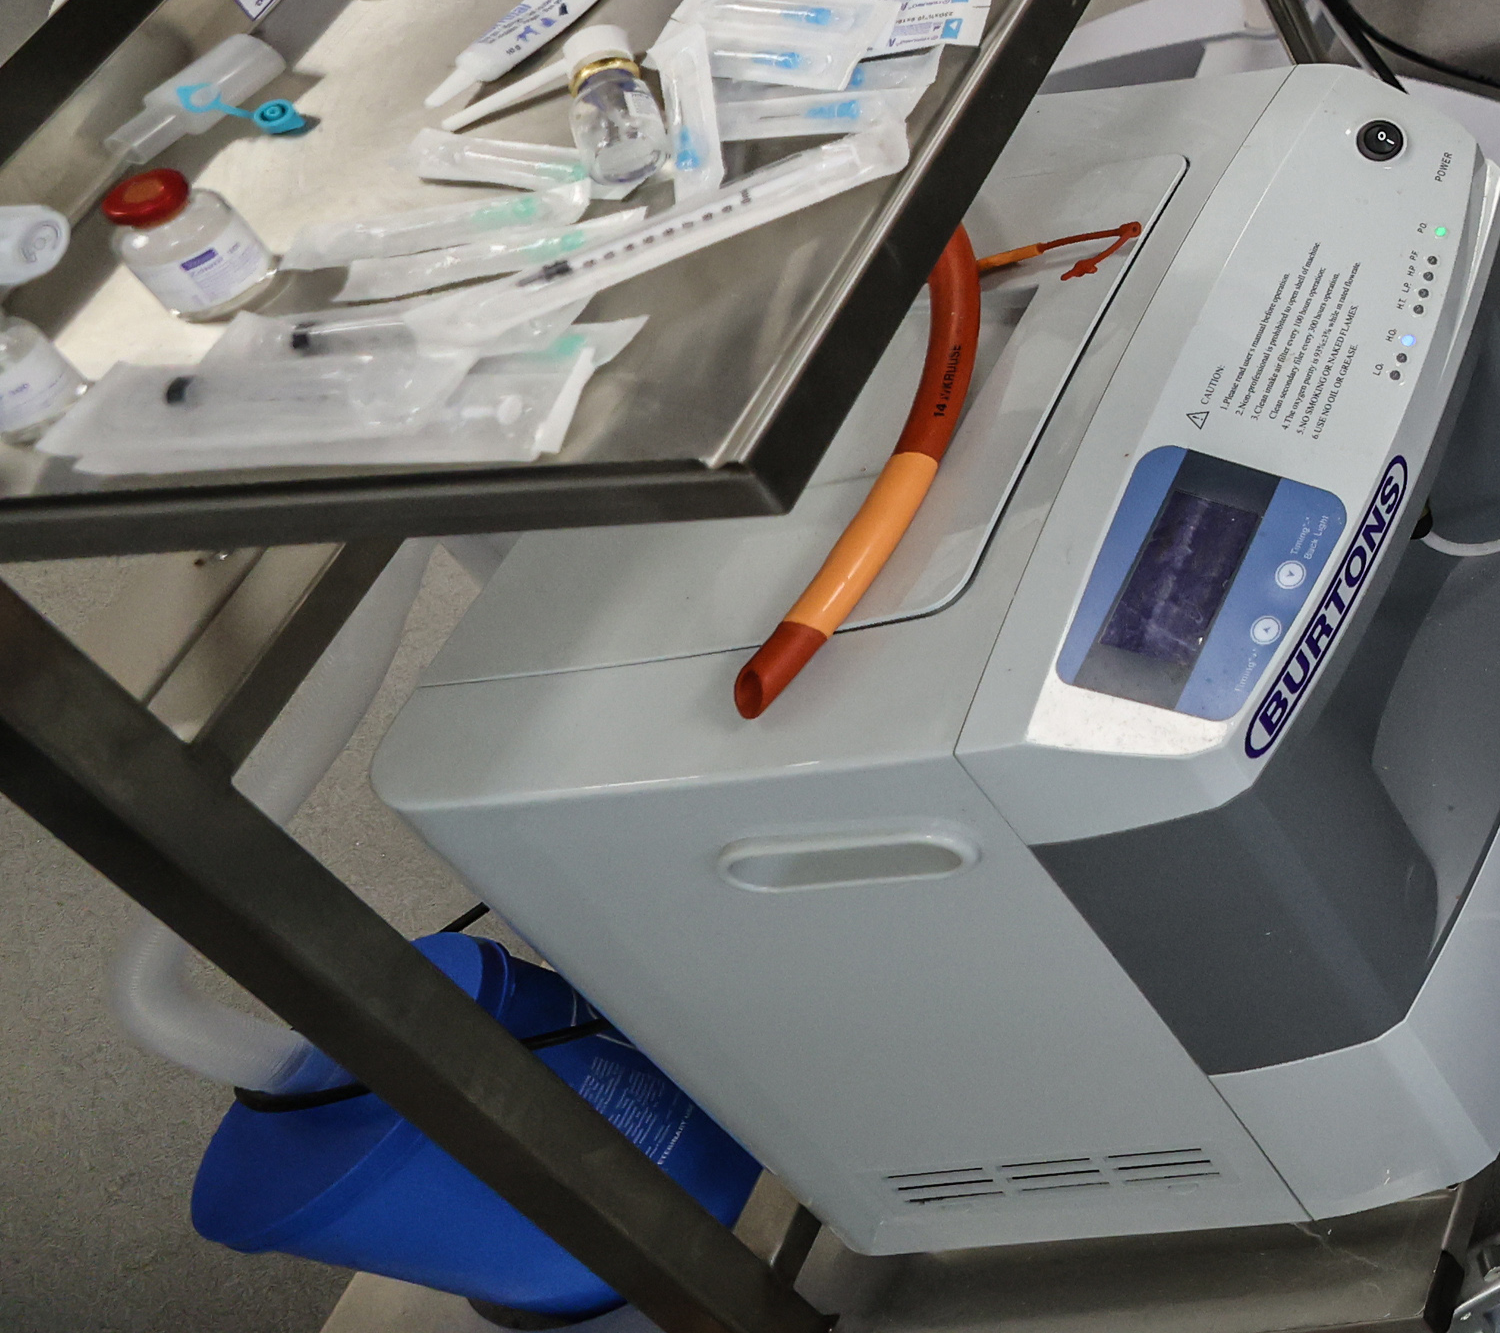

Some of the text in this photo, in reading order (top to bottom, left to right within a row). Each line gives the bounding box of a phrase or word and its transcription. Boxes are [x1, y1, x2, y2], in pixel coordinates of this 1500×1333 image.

[1435, 152, 1453, 183] POWER
[1299, 266, 1309, 275] of
[1293, 273, 1305, 290] shell
[1287, 289, 1300, 306] open
[1337, 286, 1350, 303] rated
[1283, 304, 1292, 313] to
[1298, 296, 1312, 316] hours
[1335, 302, 1343, 311] in
[1292, 313, 1304, 327] 100
[1325, 308, 1340, 328] while
[1267, 311, 1289, 346] prohibited
[1285, 327, 1299, 347] every
[1219, 381, 1239, 411] 1.Please
[1233, 365, 1246, 382] read
[1249, 322, 1266, 348] manual
[1261, 301, 1276, 324] before
[1264, 344, 1273, 352] is
[1276, 345, 1290, 363] filter
[1326, 335, 1345, 365] NAKED
[1267, 397, 1283, 420] Clean
[1276, 363, 1300, 399] secondary
[1300, 332, 1314, 352] every
[1307, 318, 1319, 332] 300
[1313, 300, 1327, 320] hours
[1273, 362, 1283, 373] air
[1310, 356, 1319, 365] is
[1301, 364, 1317, 385] purity
[1321, 363, 1333, 377] OR
[1199, 362, 1225, 405] CAUTION:
[1262, 371, 1278, 394] intake
[1332, 374, 1345, 389] OR
[1290, 384, 1308, 410] oxygen
[1304, 375, 1328, 415] SMOKING
[1326, 387, 1339, 404] OIL
[1320, 402, 1333, 416] NO
[1304, 514, 1330, 560] Back Light
[1258, 475, 1401, 737] BURTONS
